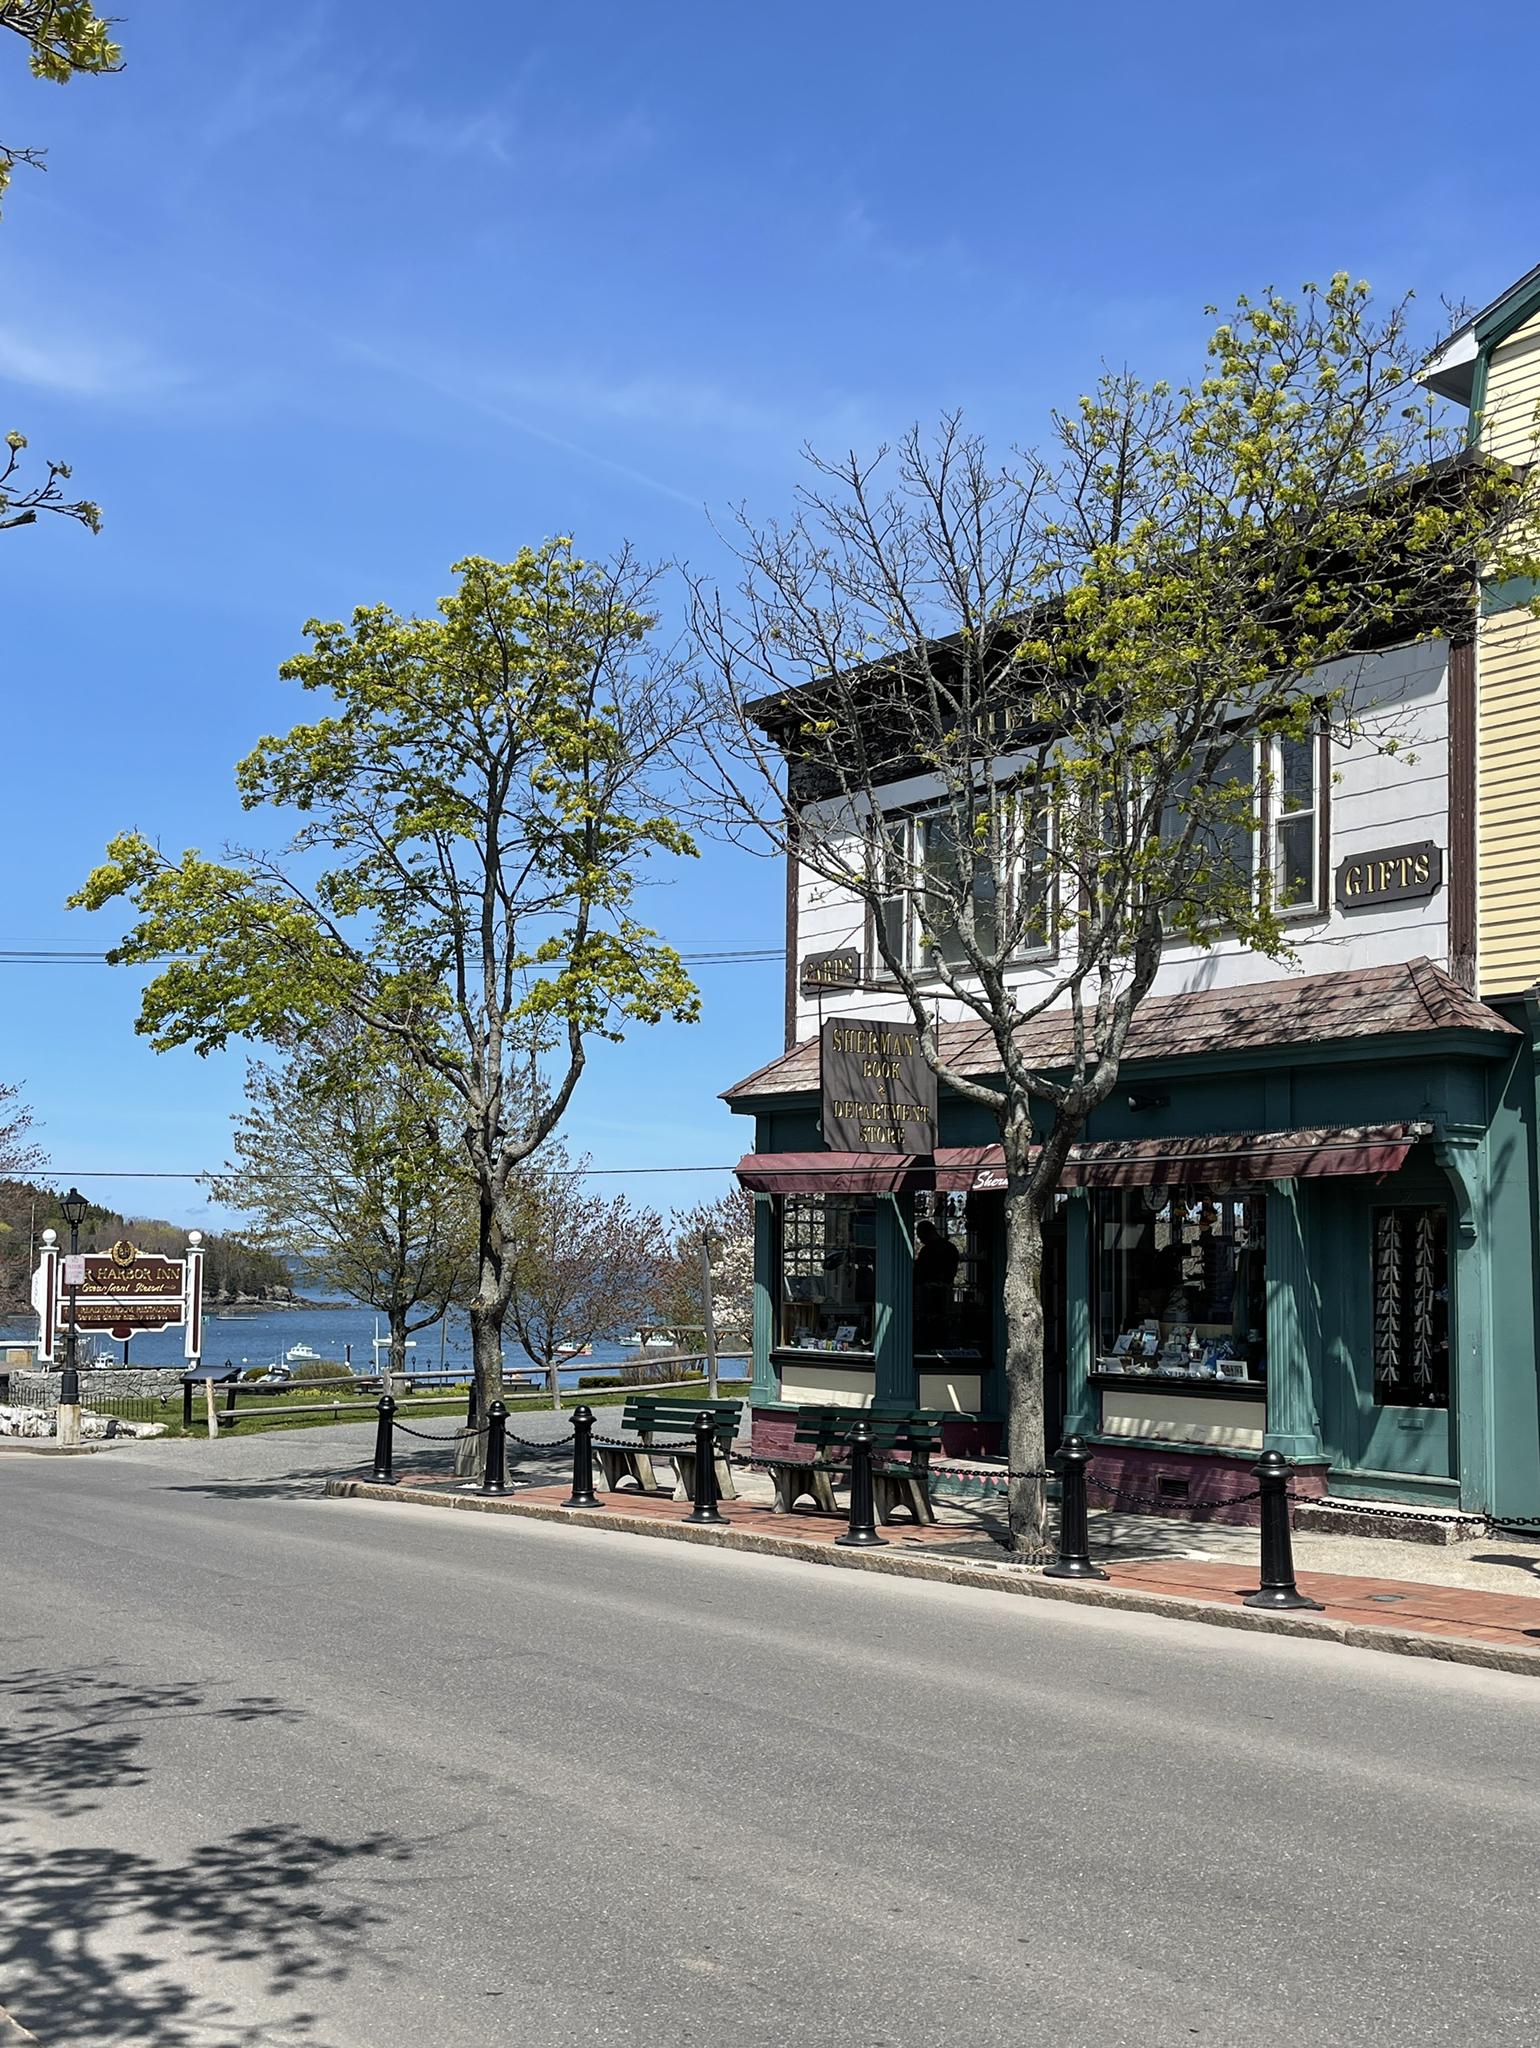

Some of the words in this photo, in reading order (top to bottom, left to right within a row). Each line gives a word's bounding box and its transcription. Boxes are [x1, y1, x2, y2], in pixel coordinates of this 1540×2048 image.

[1345, 853, 1430, 896] GIFTS
[833, 1028, 924, 1057] SHERMAN'
[863, 1060, 901, 1079] BOOK
[833, 1101, 929, 1122] DEPARTMENT
[859, 1125, 905, 1145] STORE
[97, 1267, 153, 1281] HARBOR
[156, 1267, 181, 1280] INN
